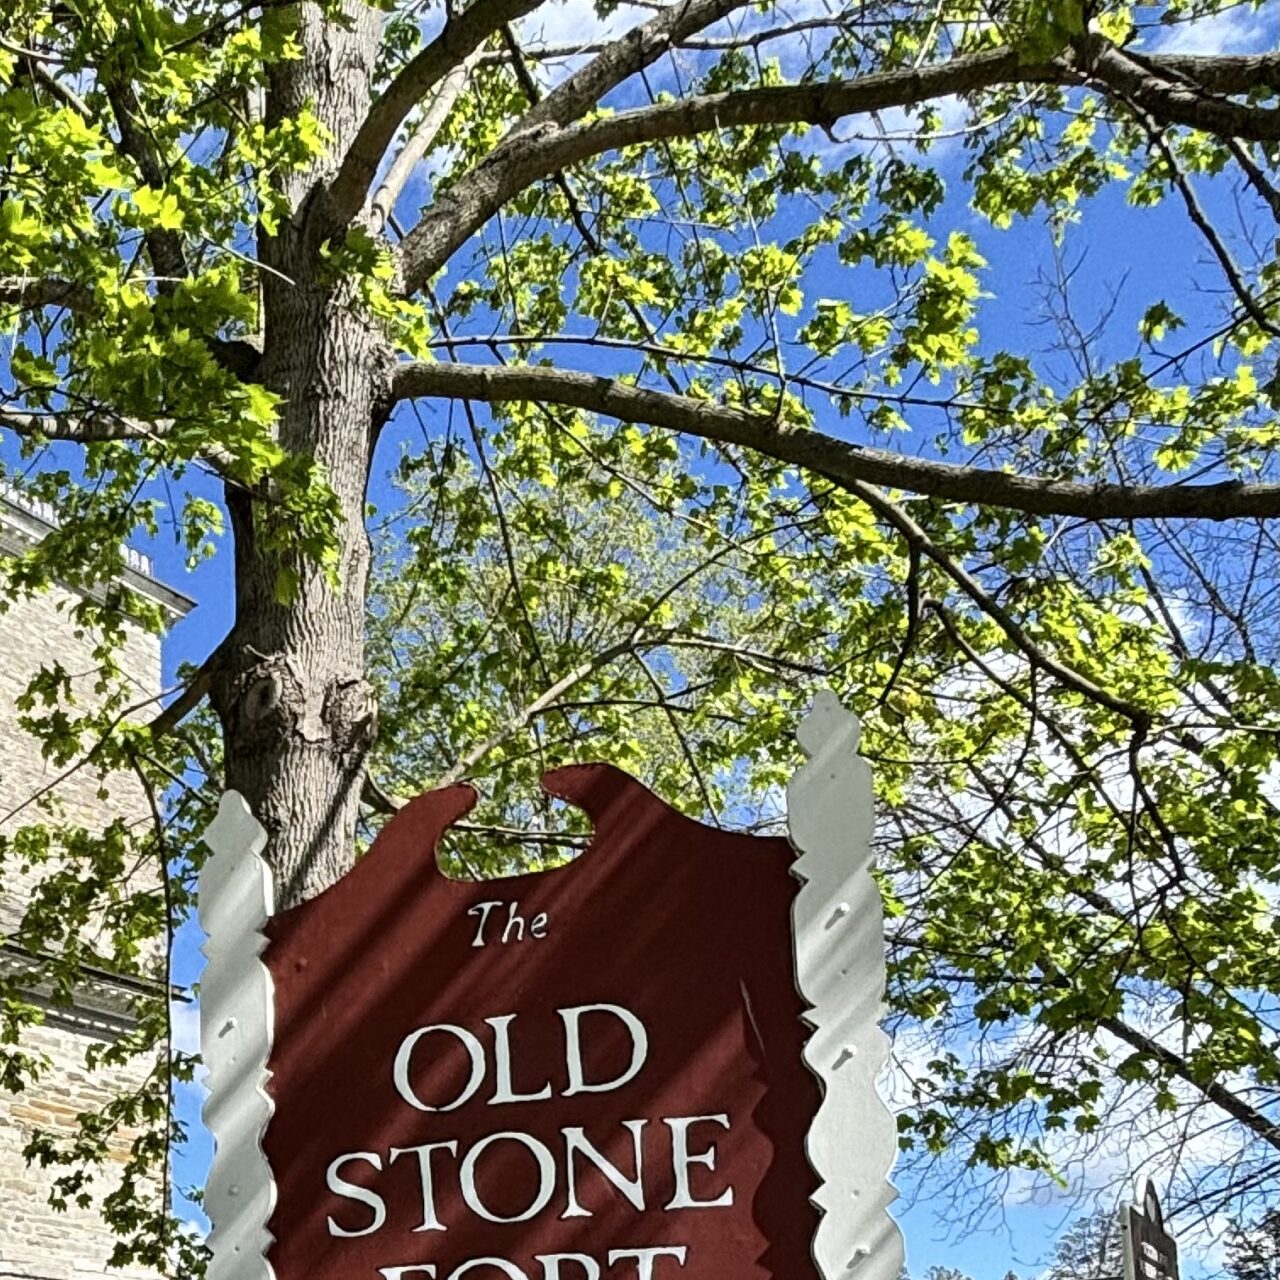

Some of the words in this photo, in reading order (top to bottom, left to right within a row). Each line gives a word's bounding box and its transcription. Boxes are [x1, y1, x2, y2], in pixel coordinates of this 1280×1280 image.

[467, 900, 549, 947] The
[393, 1003, 649, 1112] OLD
[326, 1113, 735, 1238] STONE
